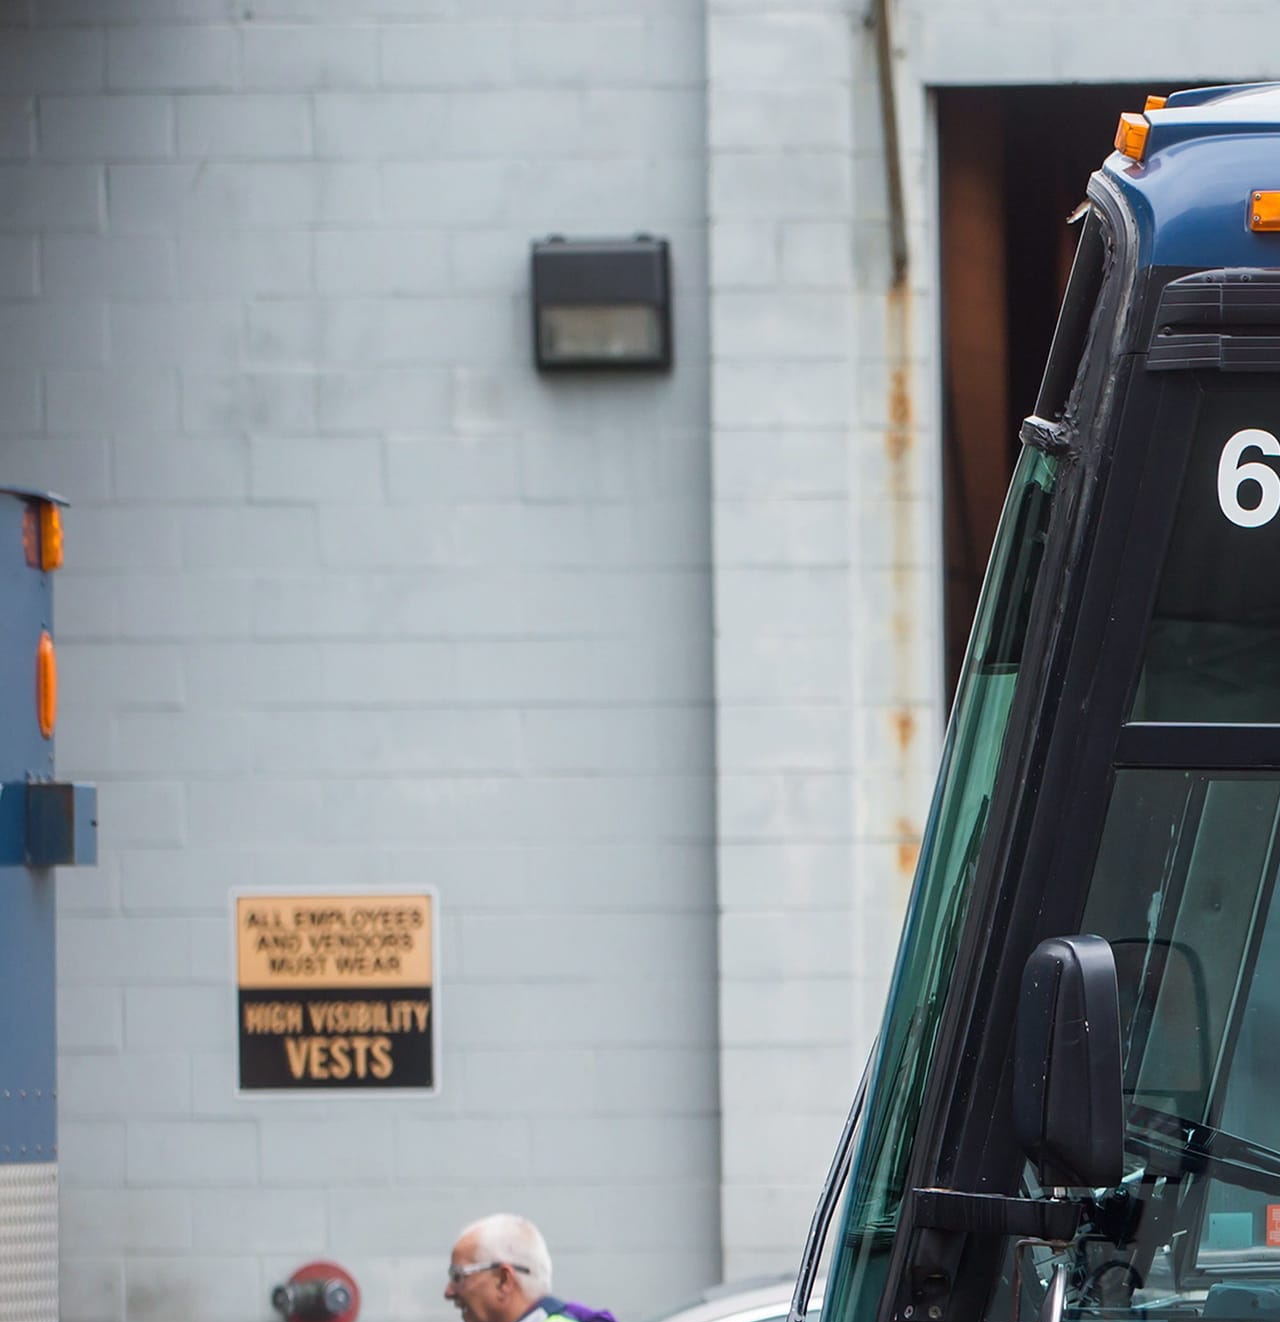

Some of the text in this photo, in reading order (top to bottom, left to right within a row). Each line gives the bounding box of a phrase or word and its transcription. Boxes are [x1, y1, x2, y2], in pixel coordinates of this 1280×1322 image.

[246, 907, 425, 929] ALL EMPLOYEES
[256, 932, 414, 952] AND VENDORS
[268, 953, 402, 975] MUST WEAR
[243, 999, 430, 1035] HIGH VISIBILITY
[284, 1035, 395, 1080] VESTS
